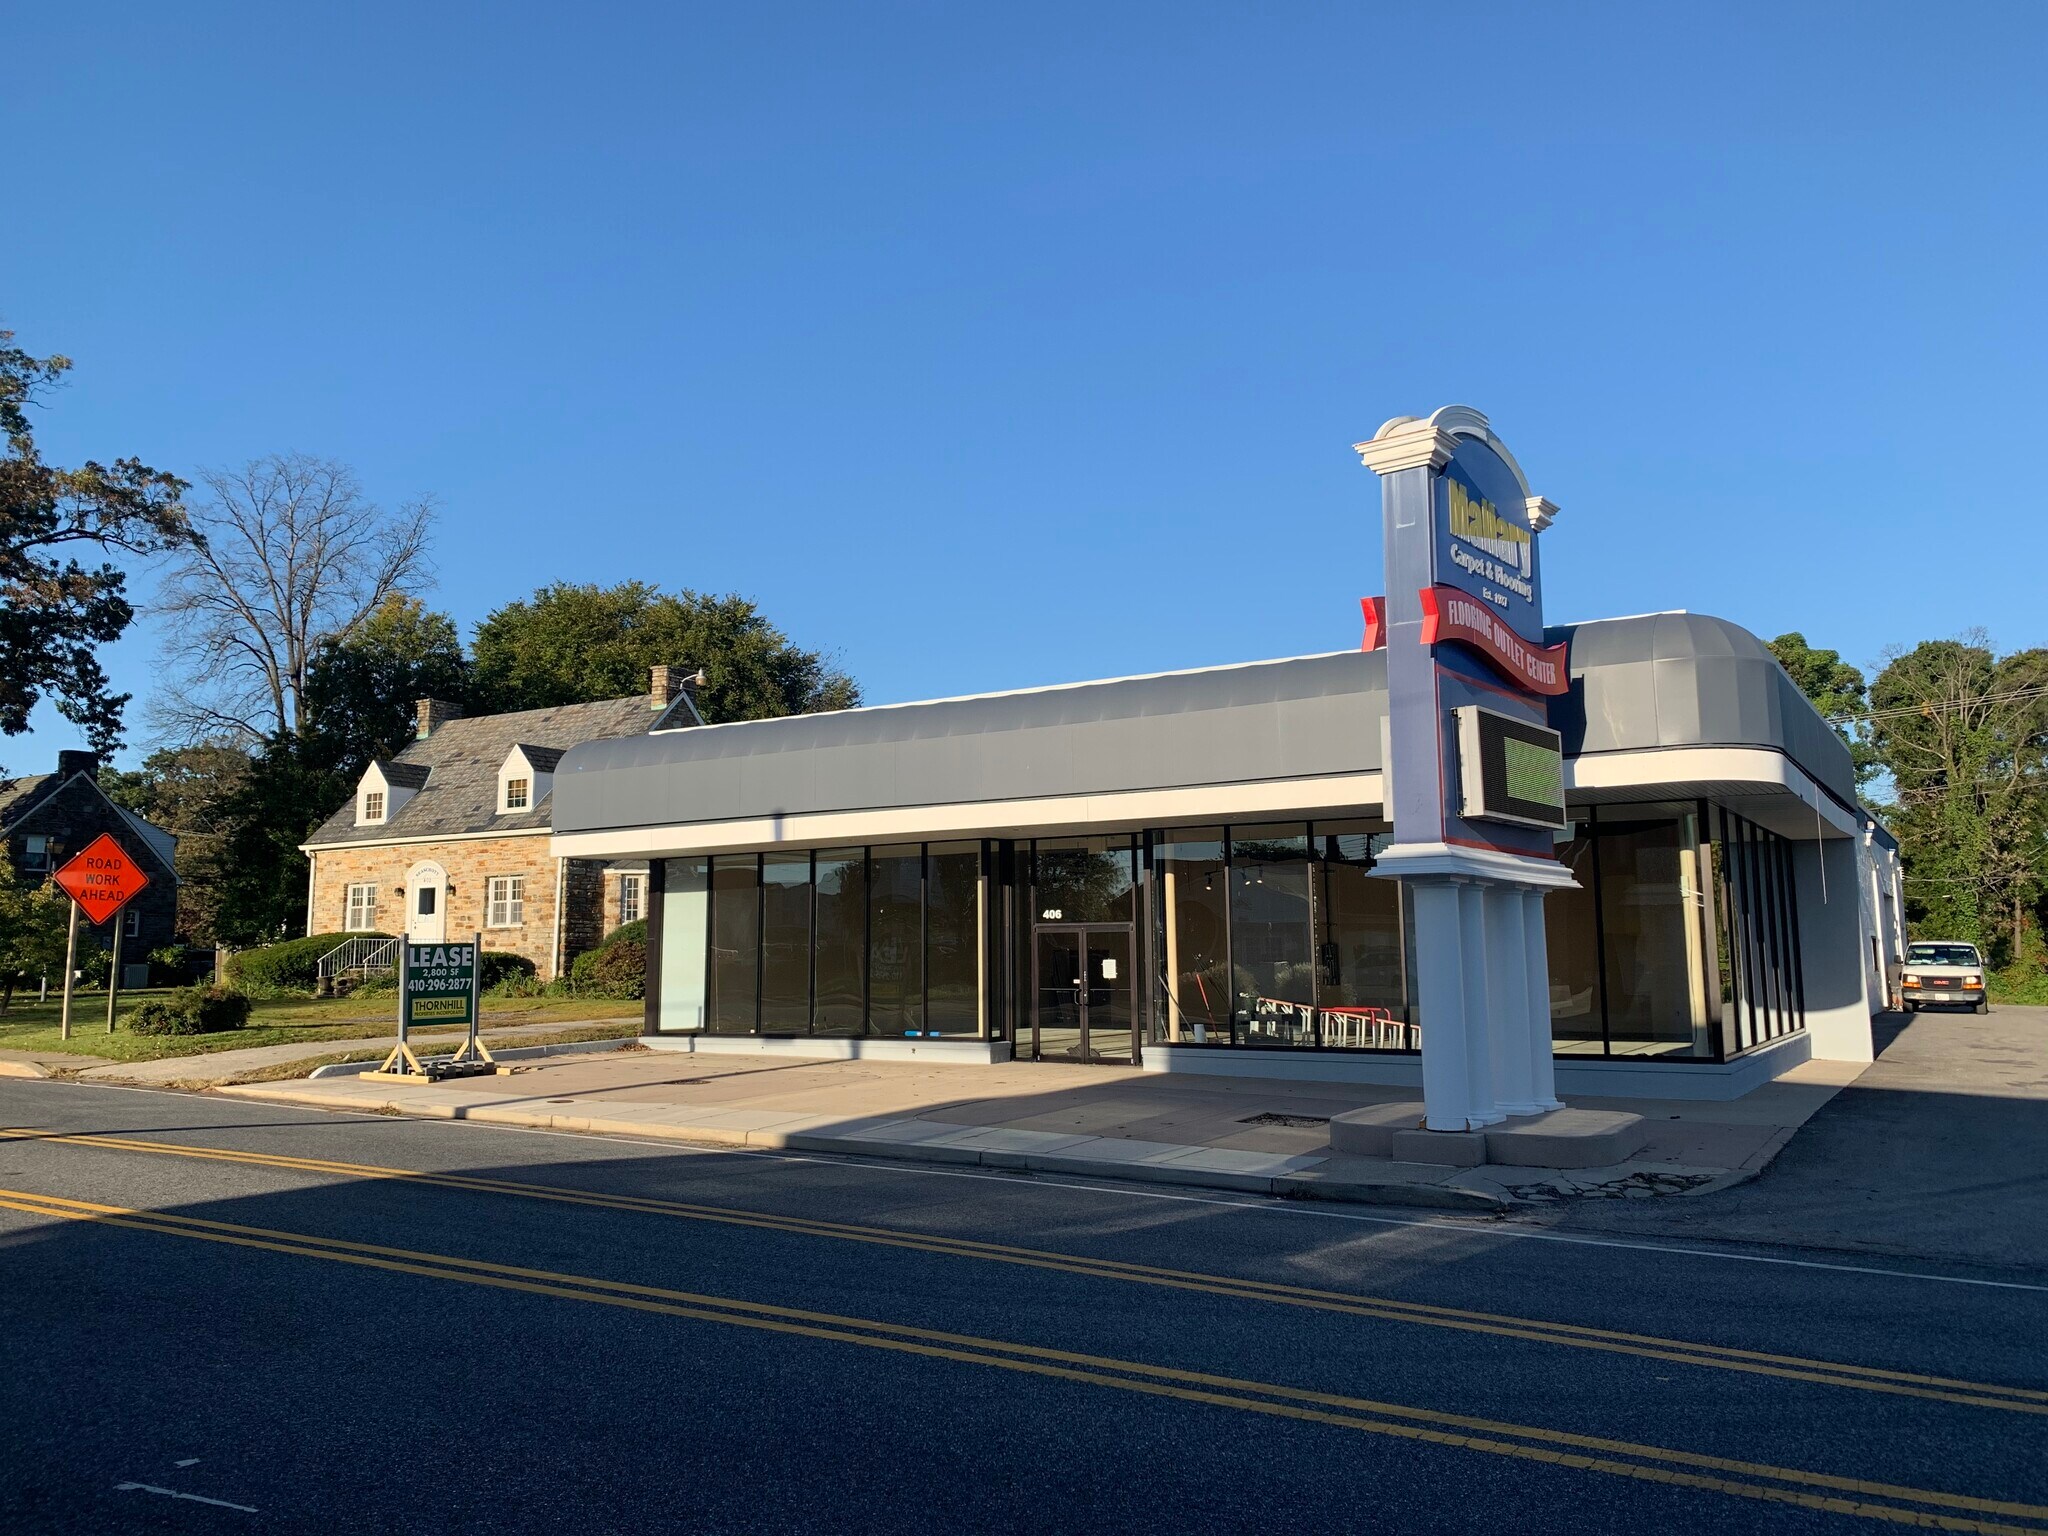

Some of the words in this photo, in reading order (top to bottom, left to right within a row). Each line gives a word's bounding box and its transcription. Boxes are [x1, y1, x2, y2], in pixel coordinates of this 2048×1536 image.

[1448, 477, 1531, 579] Mallary
[1450, 543, 1485, 577] Carpet
[1485, 560, 1494, 581] &
[1494, 565, 1532, 603] Flooring
[1482, 586, 1493, 601] Est.
[1448, 600, 1492, 641] FLOORING
[1493, 622, 1525, 670] OUTLET
[1526, 653, 1557, 685] CENTER
[86, 857, 122, 870] ROAD
[85, 873, 120, 886] WORK
[79, 889, 125, 902] AHEAD
[1042, 909, 1062, 919] 406
[409, 946, 473, 967] LEASE
[422, 968, 447, 978] 2,800
[449, 968, 460, 976] SF
[408, 977, 473, 991] 410-296-2877
[414, 1000, 465, 1012] THORNHILL
